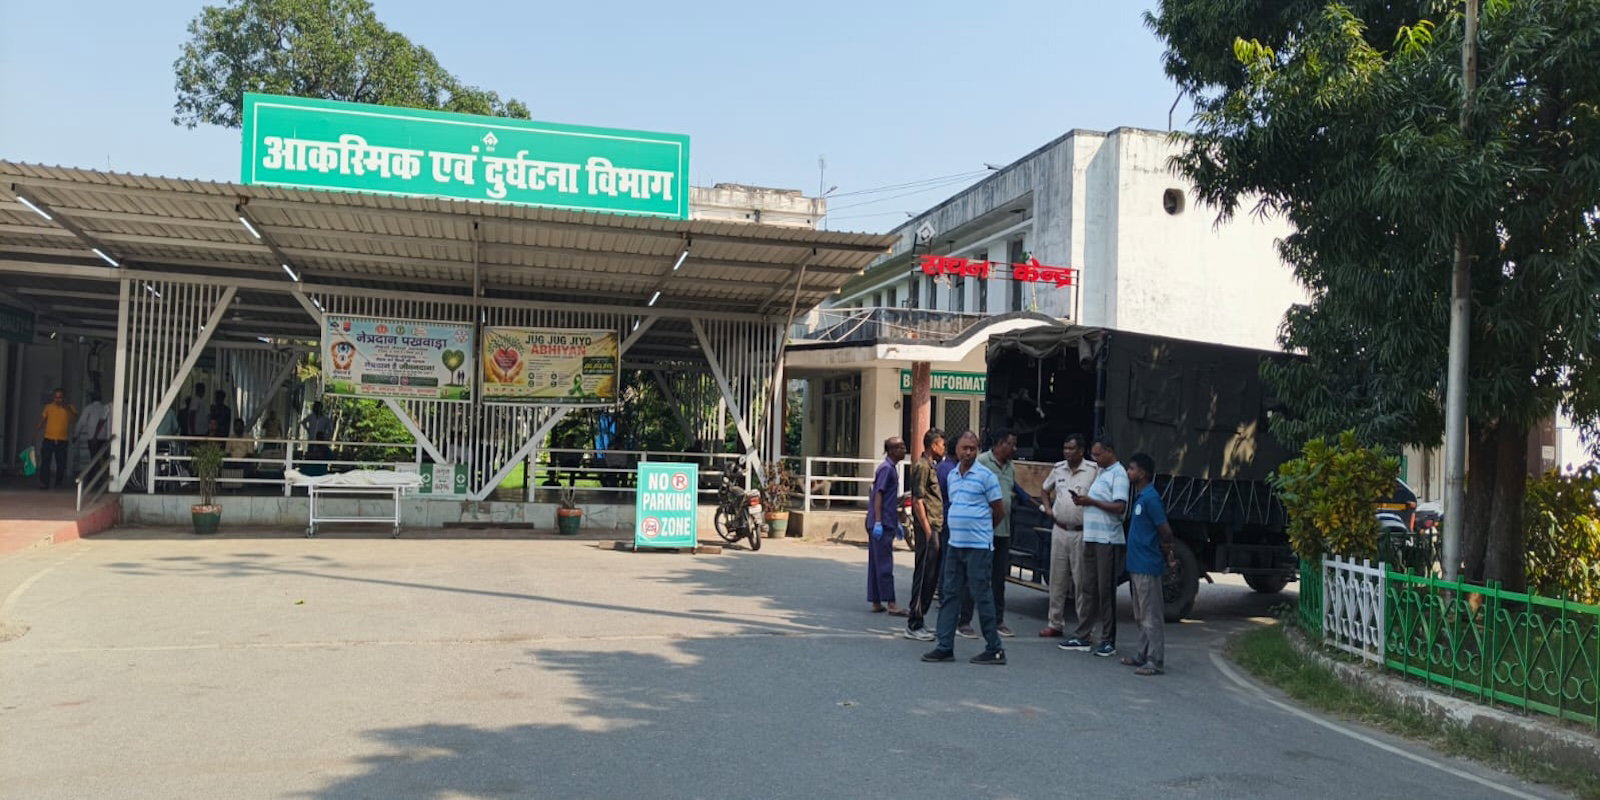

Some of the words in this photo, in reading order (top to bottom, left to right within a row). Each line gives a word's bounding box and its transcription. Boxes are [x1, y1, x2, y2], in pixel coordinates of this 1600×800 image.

[262, 134, 424, 179] आकस्मिक
[429, 145, 479, 185] एवं
[483, 150, 580, 198] दुर्घटना
[586, 157, 674, 201] विभाग
[357, 331, 398, 345] नेत्रदान
[401, 336, 448, 350] पखवाड़ा
[525, 335, 544, 345] JUG
[547, 336, 566, 345] JUG
[569, 336, 592, 346] JIYO
[530, 344, 588, 355] ABHIYAN
[929, 374, 986, 391] INFORMAT
[648, 473, 669, 490] NO
[642, 492, 692, 511] PARKING
[661, 517, 691, 536] ZONE
